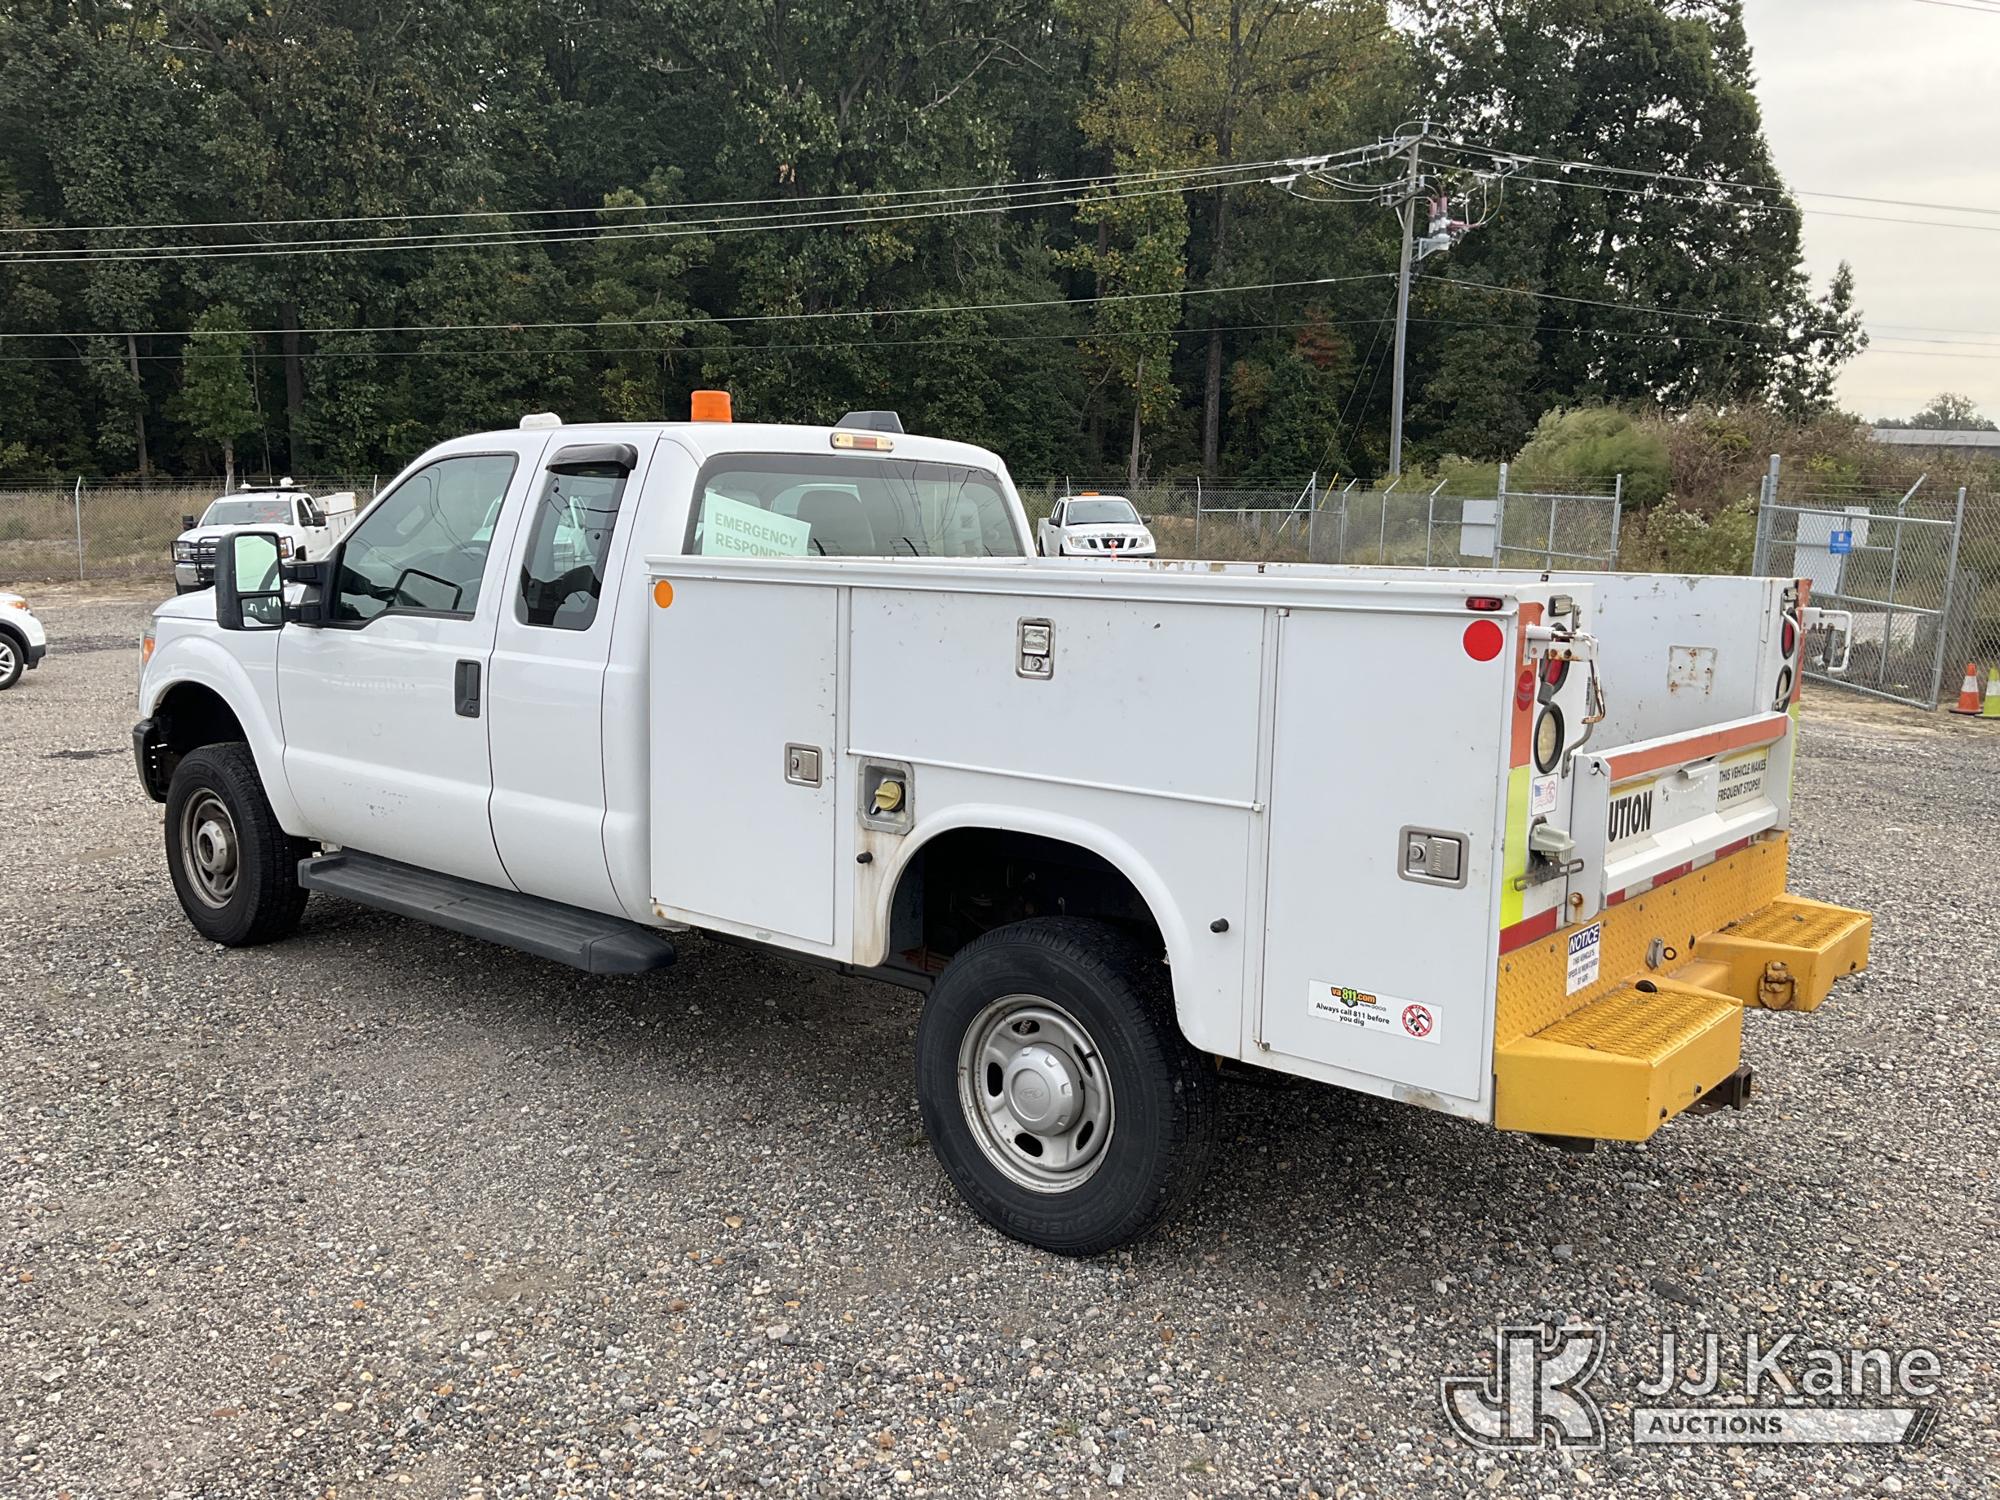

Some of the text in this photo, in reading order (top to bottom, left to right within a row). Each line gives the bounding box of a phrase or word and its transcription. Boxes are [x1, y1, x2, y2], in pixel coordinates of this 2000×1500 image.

[714, 513, 797, 548] EMERGENCY
[715, 533, 793, 556] RESPON
[1717, 783, 1743, 801] FREQUENT
[1569, 927, 1599, 954] NOTICE
[1315, 1002, 1390, 1024] Always call 811 before
[1339, 1014, 1365, 1026] you dig
